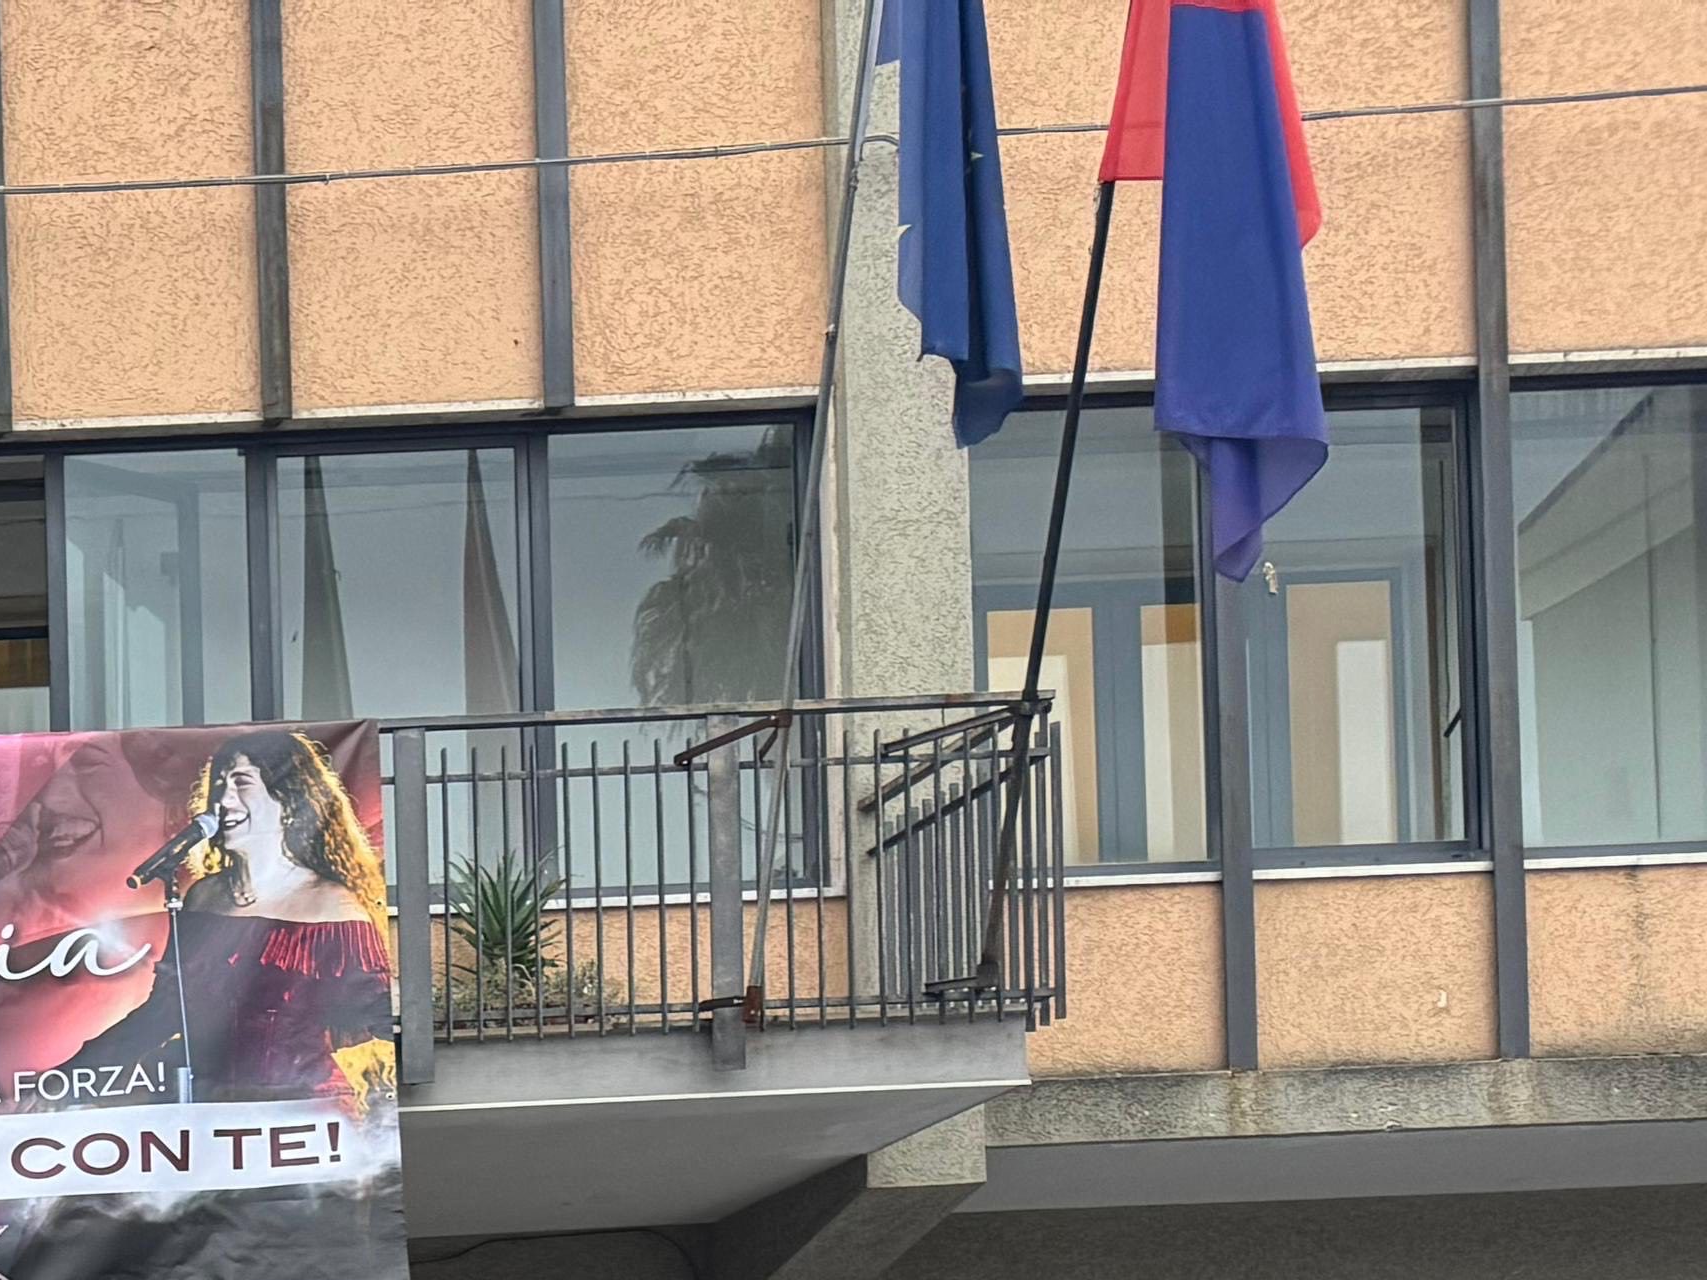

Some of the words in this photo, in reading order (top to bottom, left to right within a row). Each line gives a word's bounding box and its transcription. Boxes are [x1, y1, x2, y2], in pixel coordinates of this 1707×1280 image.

[13, 1062, 165, 1102] FORZA!
[11, 1129, 190, 1179] CON
[212, 1122, 342, 1170] TE!
